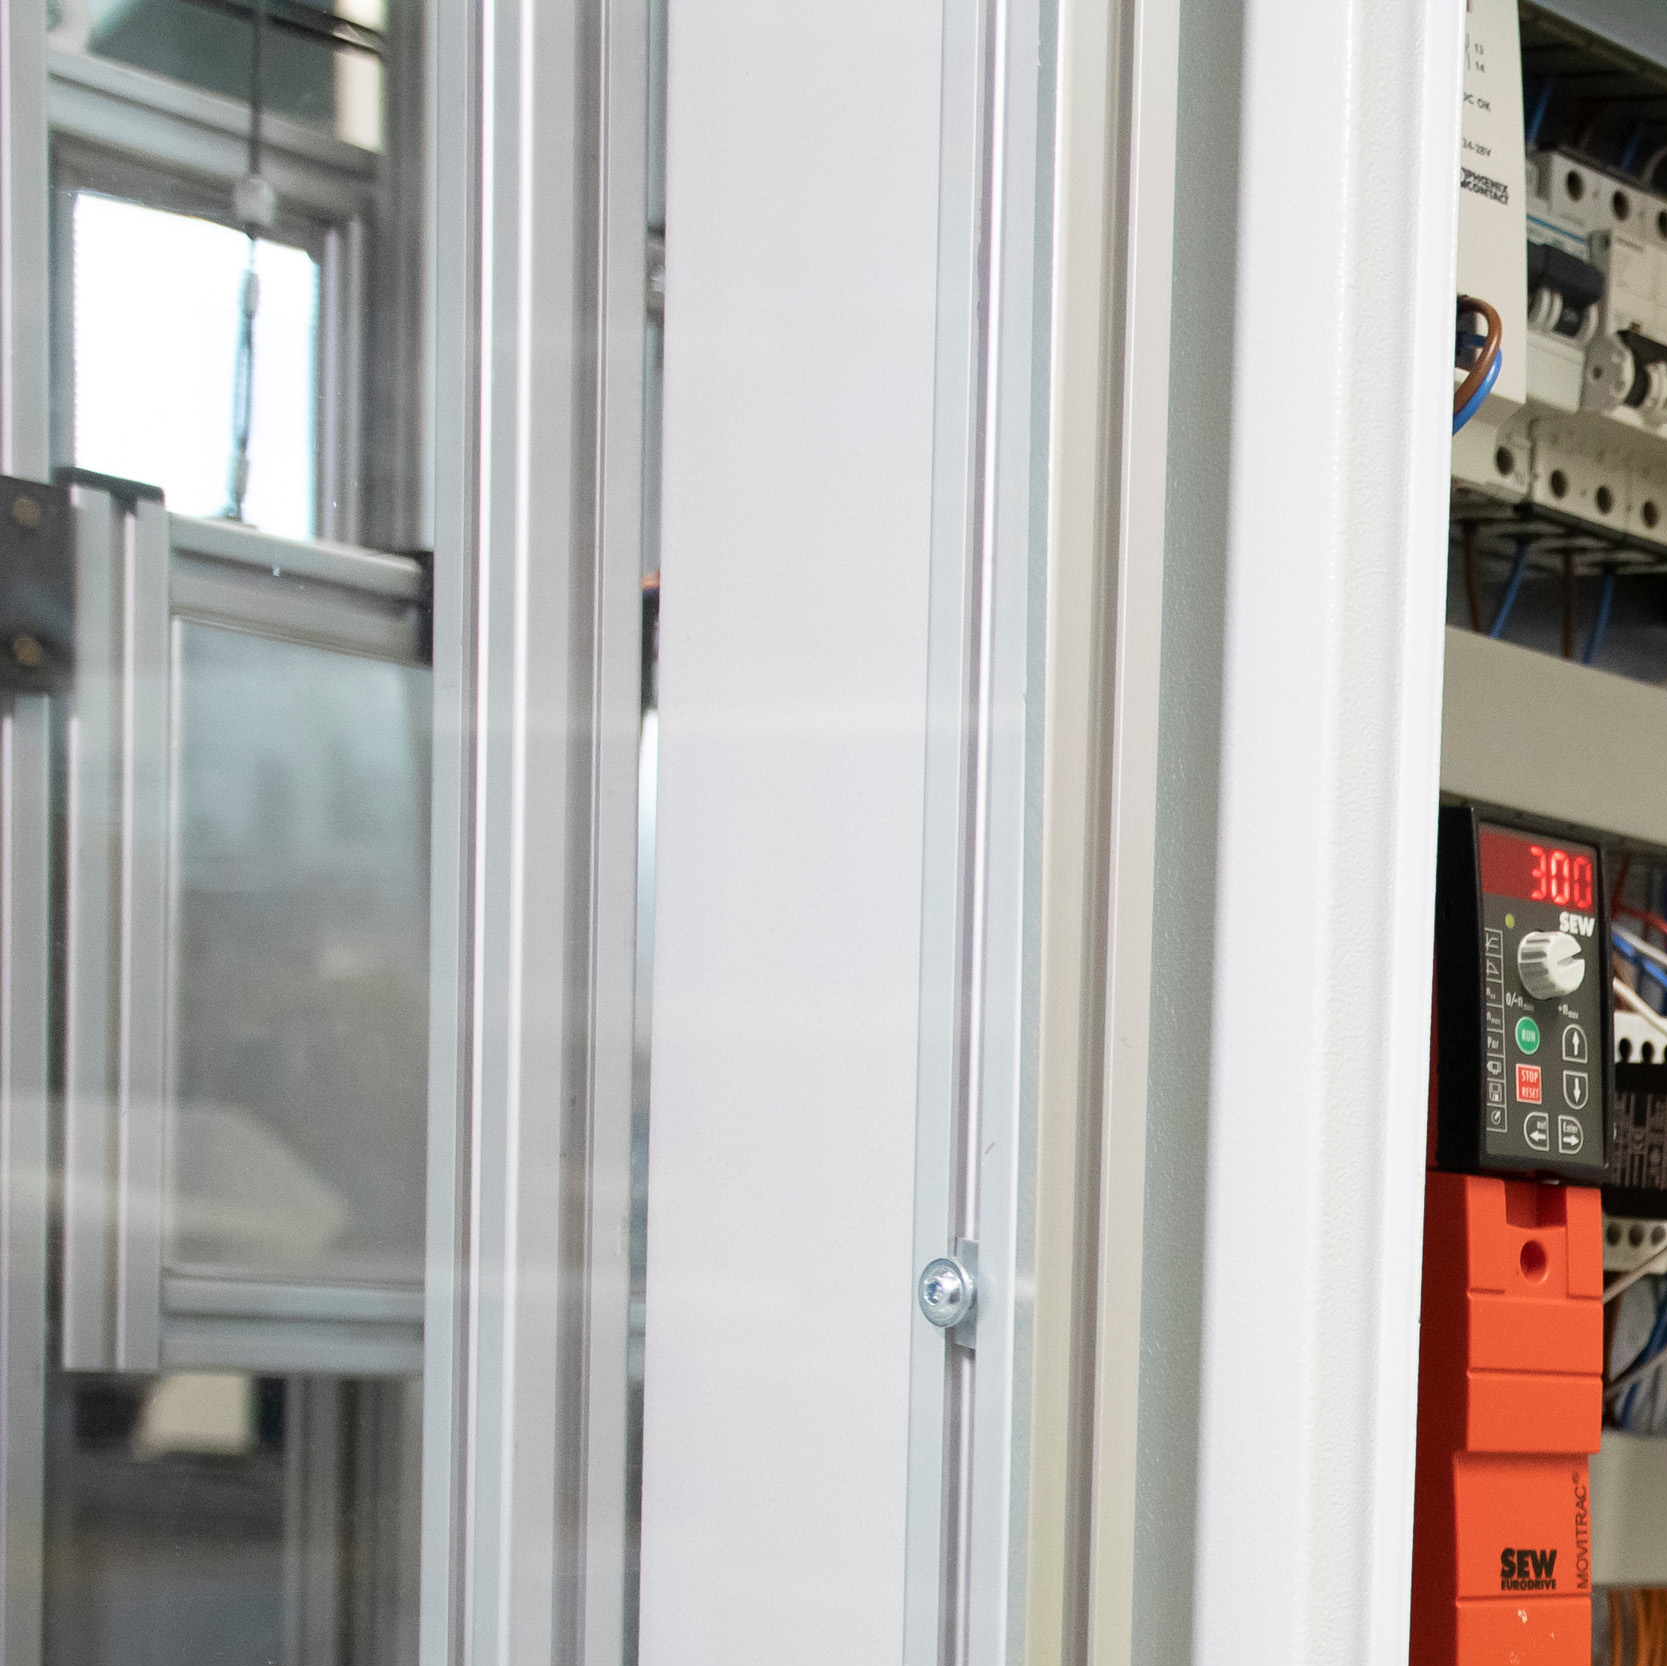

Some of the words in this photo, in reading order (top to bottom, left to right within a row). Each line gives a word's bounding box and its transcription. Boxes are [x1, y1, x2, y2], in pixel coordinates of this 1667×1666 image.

[1529, 845, 1593, 909] 300
[1559, 911, 1595, 937] SEW
[1522, 1028, 1536, 1042] RUN
[1521, 1069, 1539, 1083] STOP
[1521, 1086, 1539, 1100] RESET
[1500, 1547, 1557, 1579] SEW
[1501, 1579, 1556, 1590] EURODRIVE
